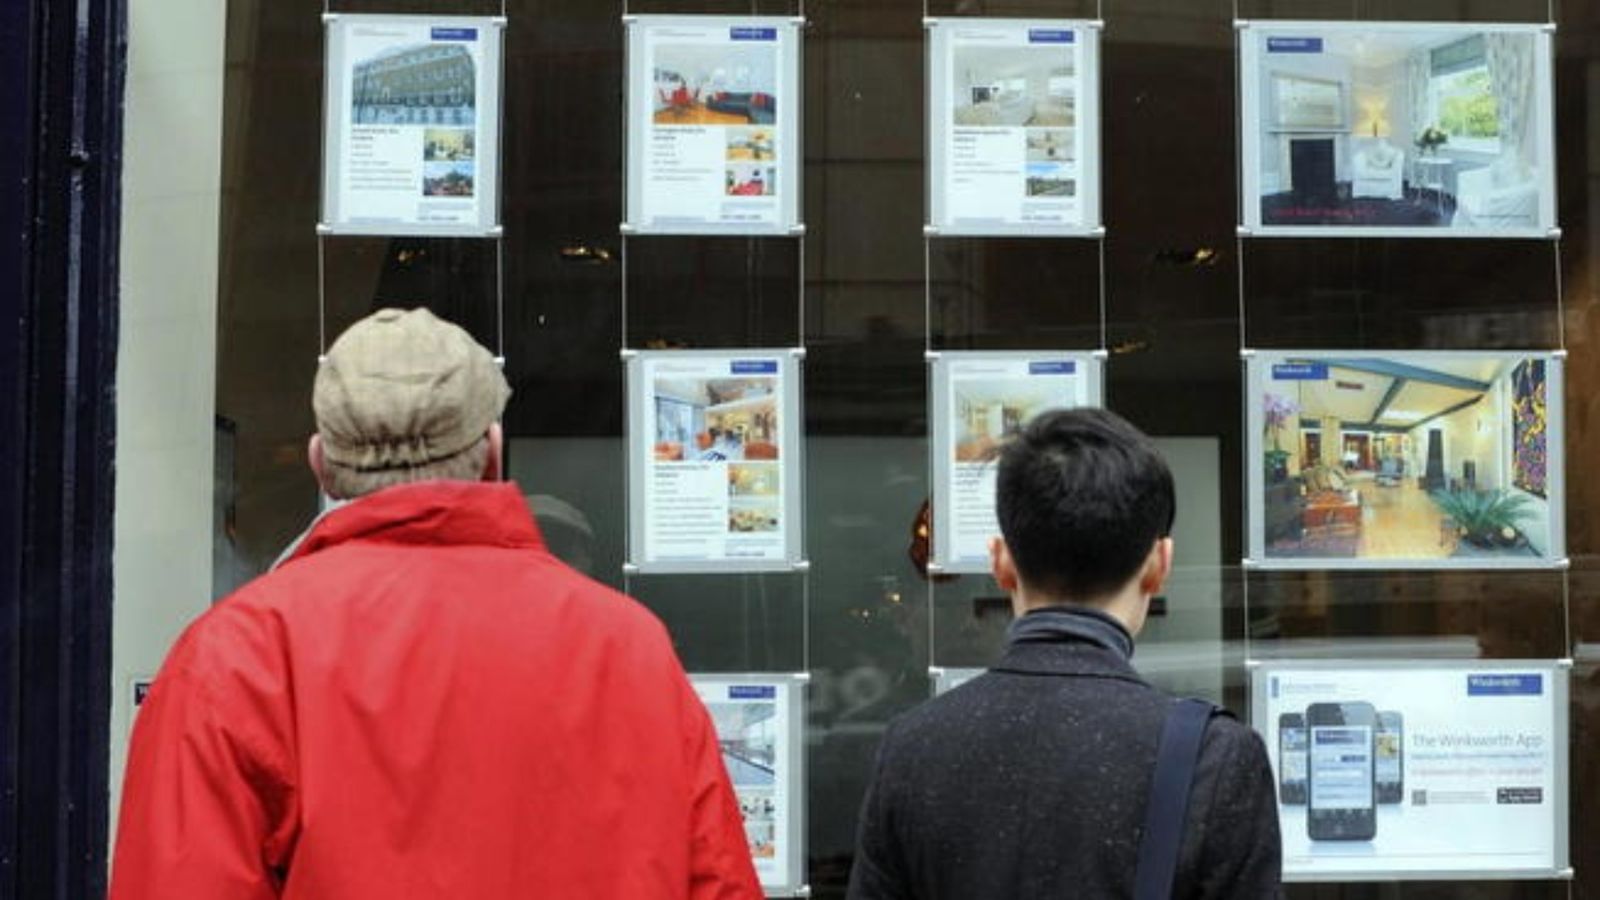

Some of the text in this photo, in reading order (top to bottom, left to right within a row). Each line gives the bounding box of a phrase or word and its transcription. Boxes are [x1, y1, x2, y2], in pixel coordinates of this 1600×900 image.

[1412, 732, 1545, 749] The Winkworth App
